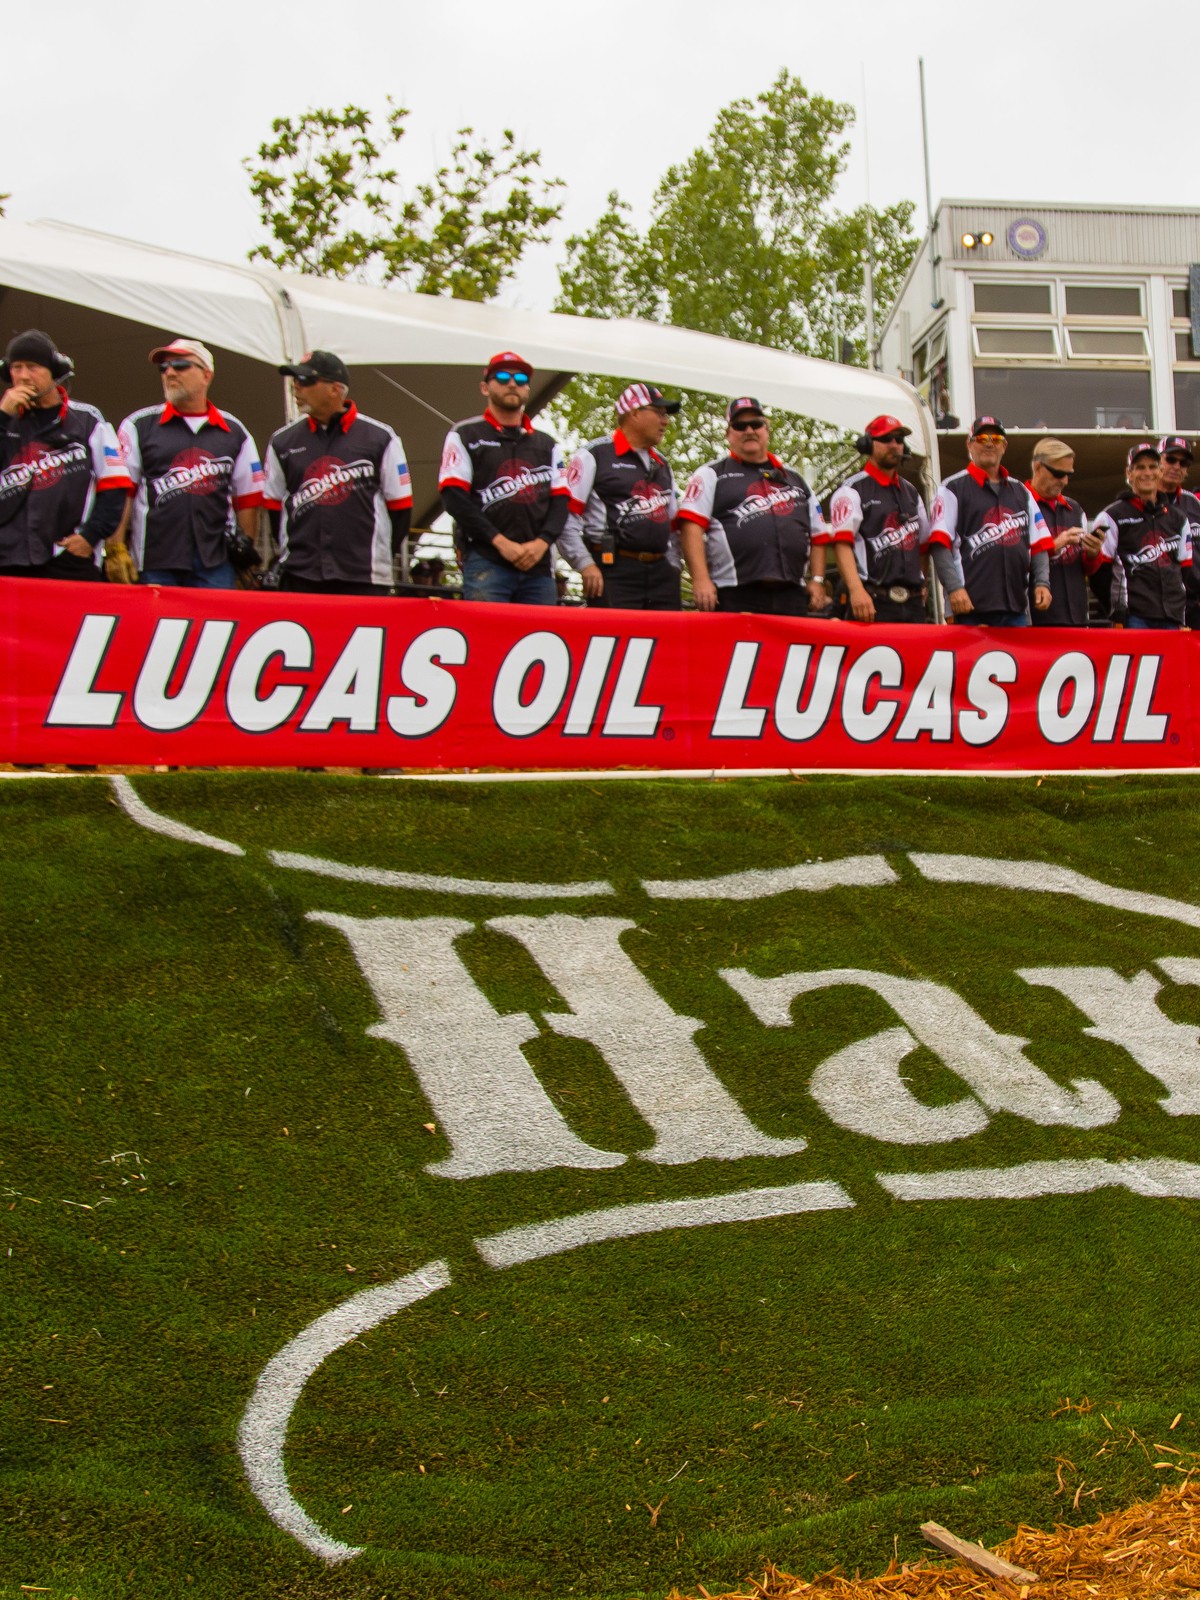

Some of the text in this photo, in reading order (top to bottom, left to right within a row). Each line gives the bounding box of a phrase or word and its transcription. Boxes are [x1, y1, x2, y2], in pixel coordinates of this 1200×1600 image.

[43, 613, 664, 738] LUCAS OIL
[711, 640, 1170, 746] LUCAS OIL
